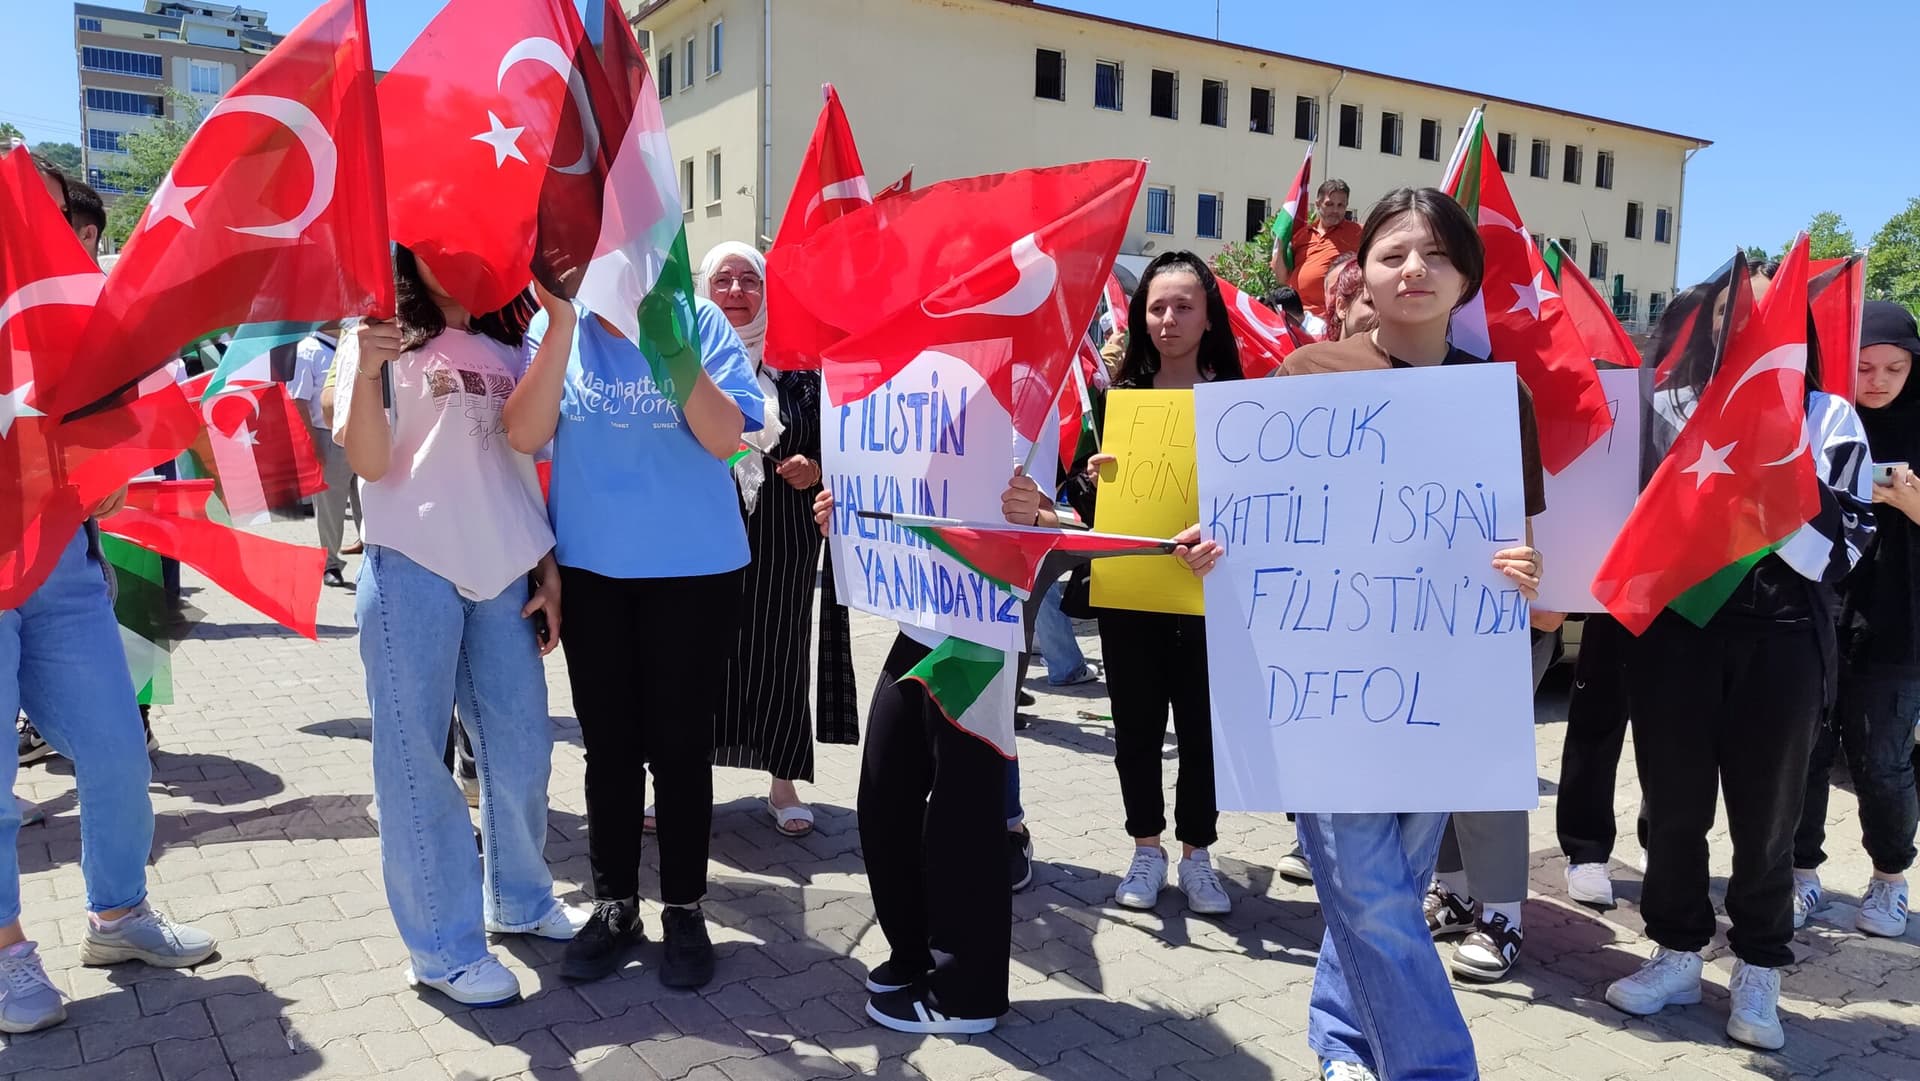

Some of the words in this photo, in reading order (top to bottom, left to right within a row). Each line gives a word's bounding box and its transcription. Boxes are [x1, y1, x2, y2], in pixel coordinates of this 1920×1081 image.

[1215, 399, 1391, 468] ÇOCUK
[830, 474, 948, 550] HALKININ
[1209, 483, 1330, 557] KATİLİ
[1371, 480, 1519, 549] İSRAİL
[1267, 665, 1441, 727] DEFOL
